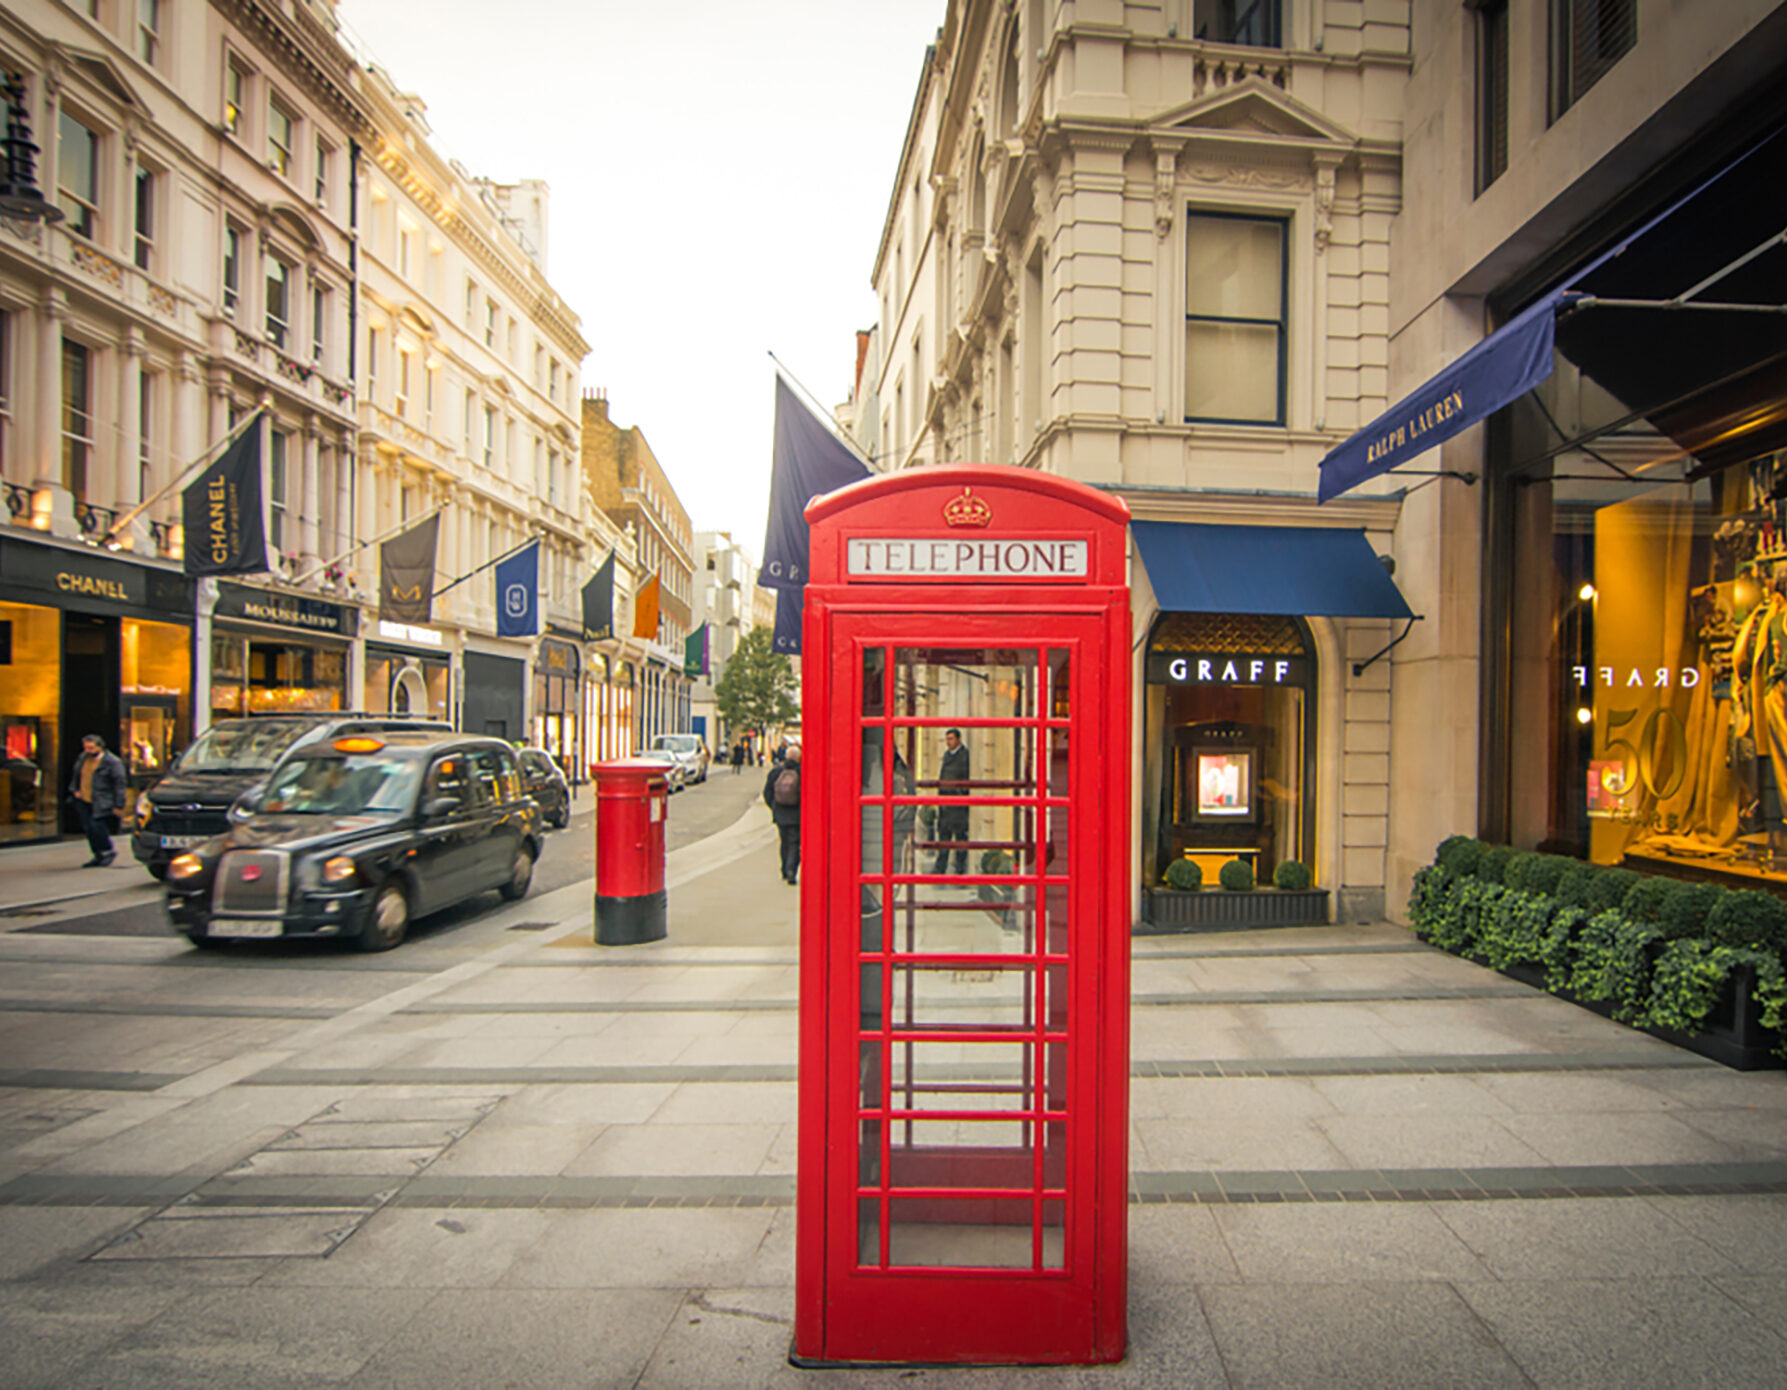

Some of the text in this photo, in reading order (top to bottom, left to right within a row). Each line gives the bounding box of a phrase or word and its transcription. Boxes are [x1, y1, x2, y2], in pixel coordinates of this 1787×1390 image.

[1367, 389, 1463, 464] RALPH LAUREN
[208, 474, 228, 564] CHANEL
[858, 542, 1078, 573] TELEPHONE
[57, 572, 128, 599] CHANEL
[1169, 659, 1289, 682] GRAFF
[1601, 707, 1687, 800] 50
